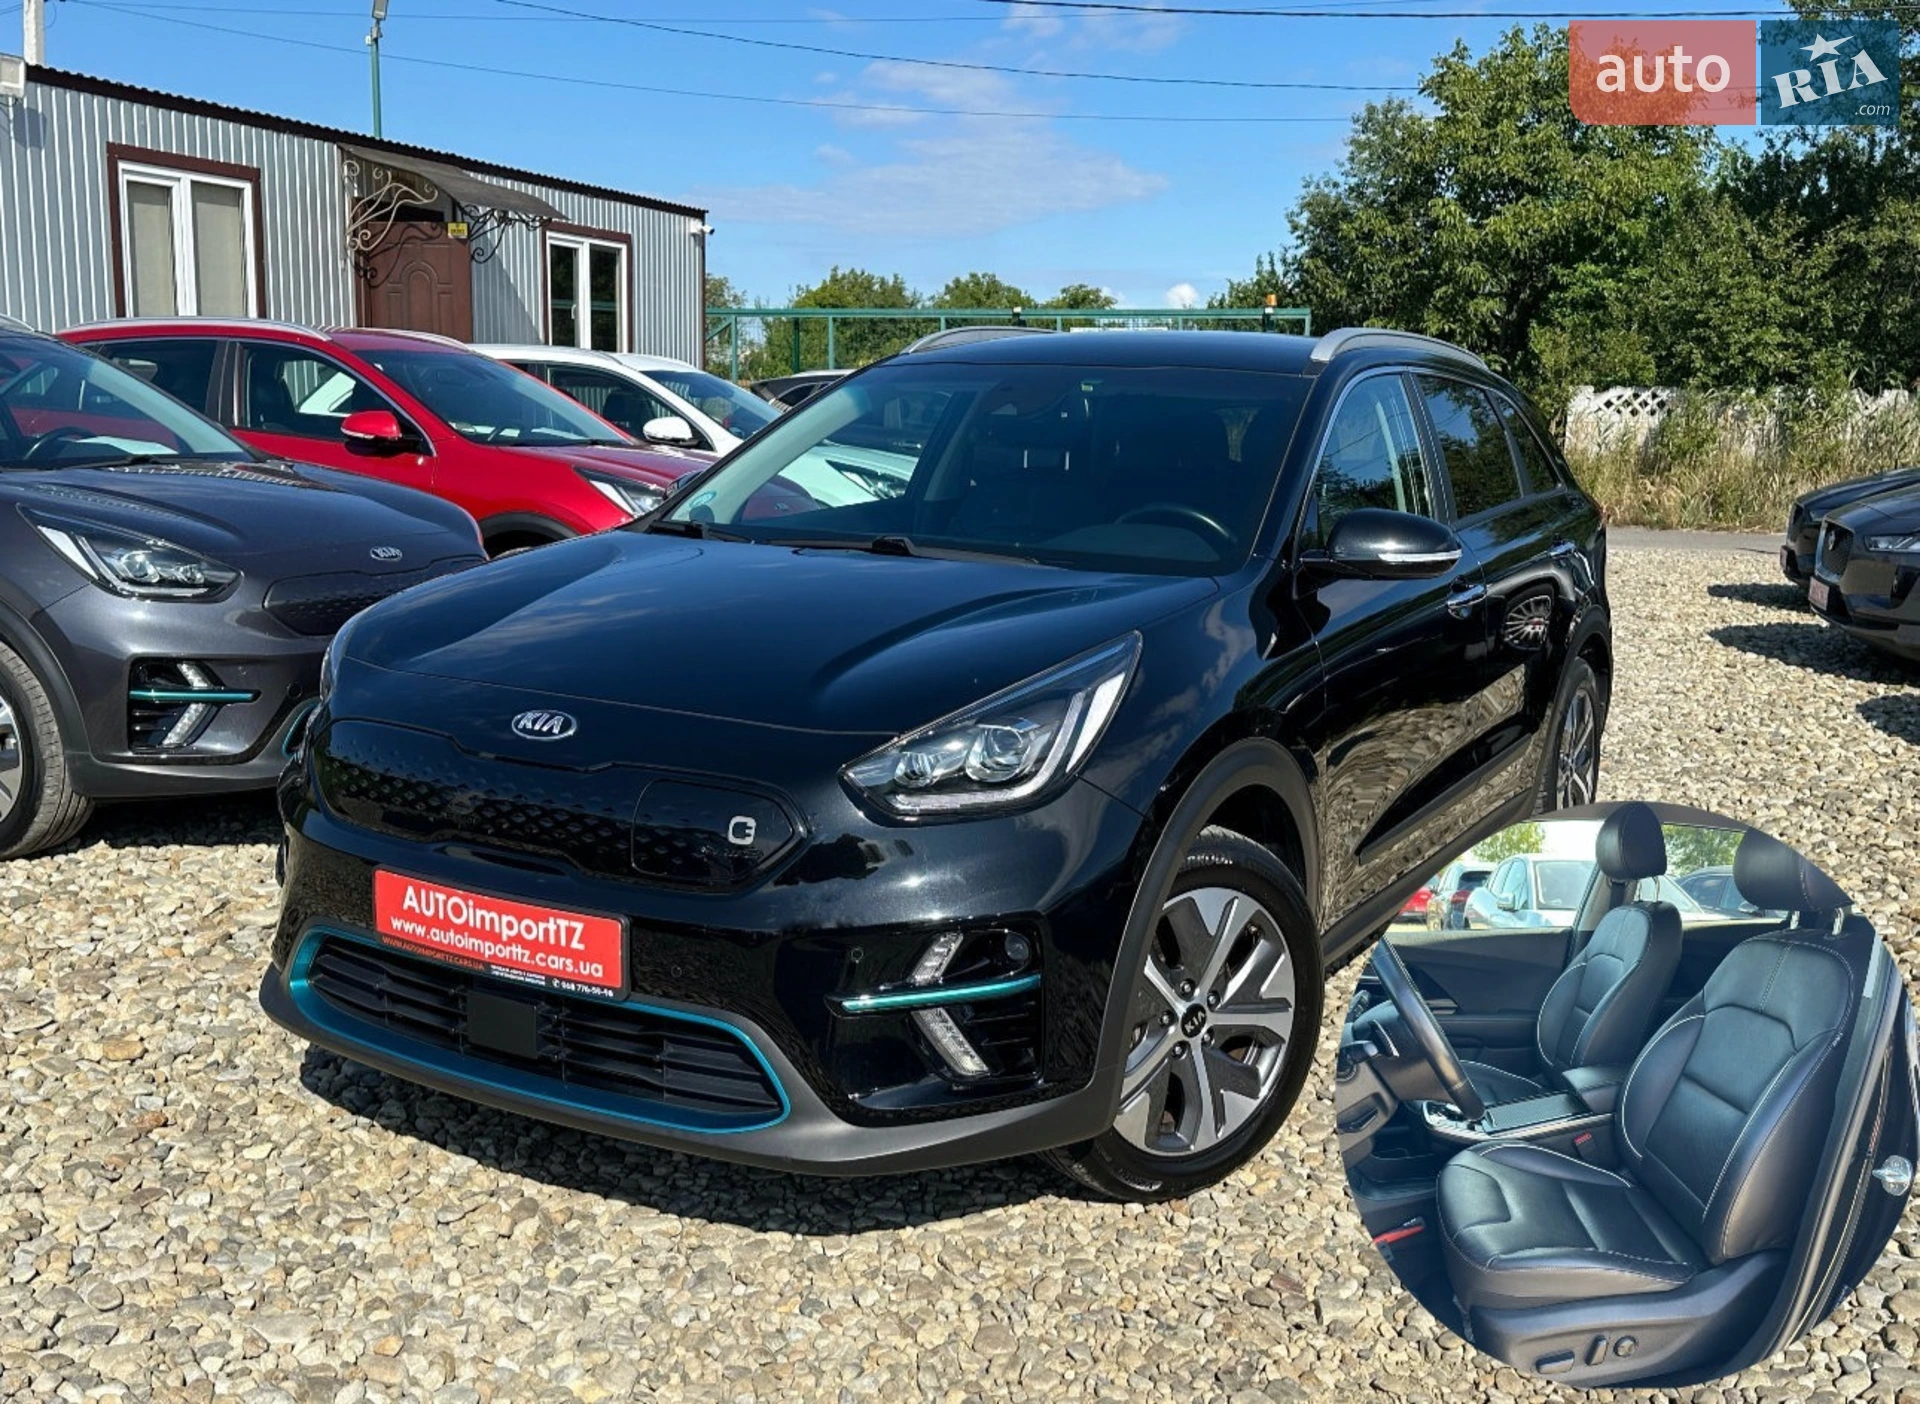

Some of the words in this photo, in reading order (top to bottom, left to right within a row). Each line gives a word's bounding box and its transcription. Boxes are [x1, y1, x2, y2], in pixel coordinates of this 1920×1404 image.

[517, 711, 565, 735] KIA
[402, 885, 586, 951] AUTOimportTZ
[390, 915, 604, 978] www.autoimporttz.cars.ua
[1184, 1010, 1205, 1033] KIA
